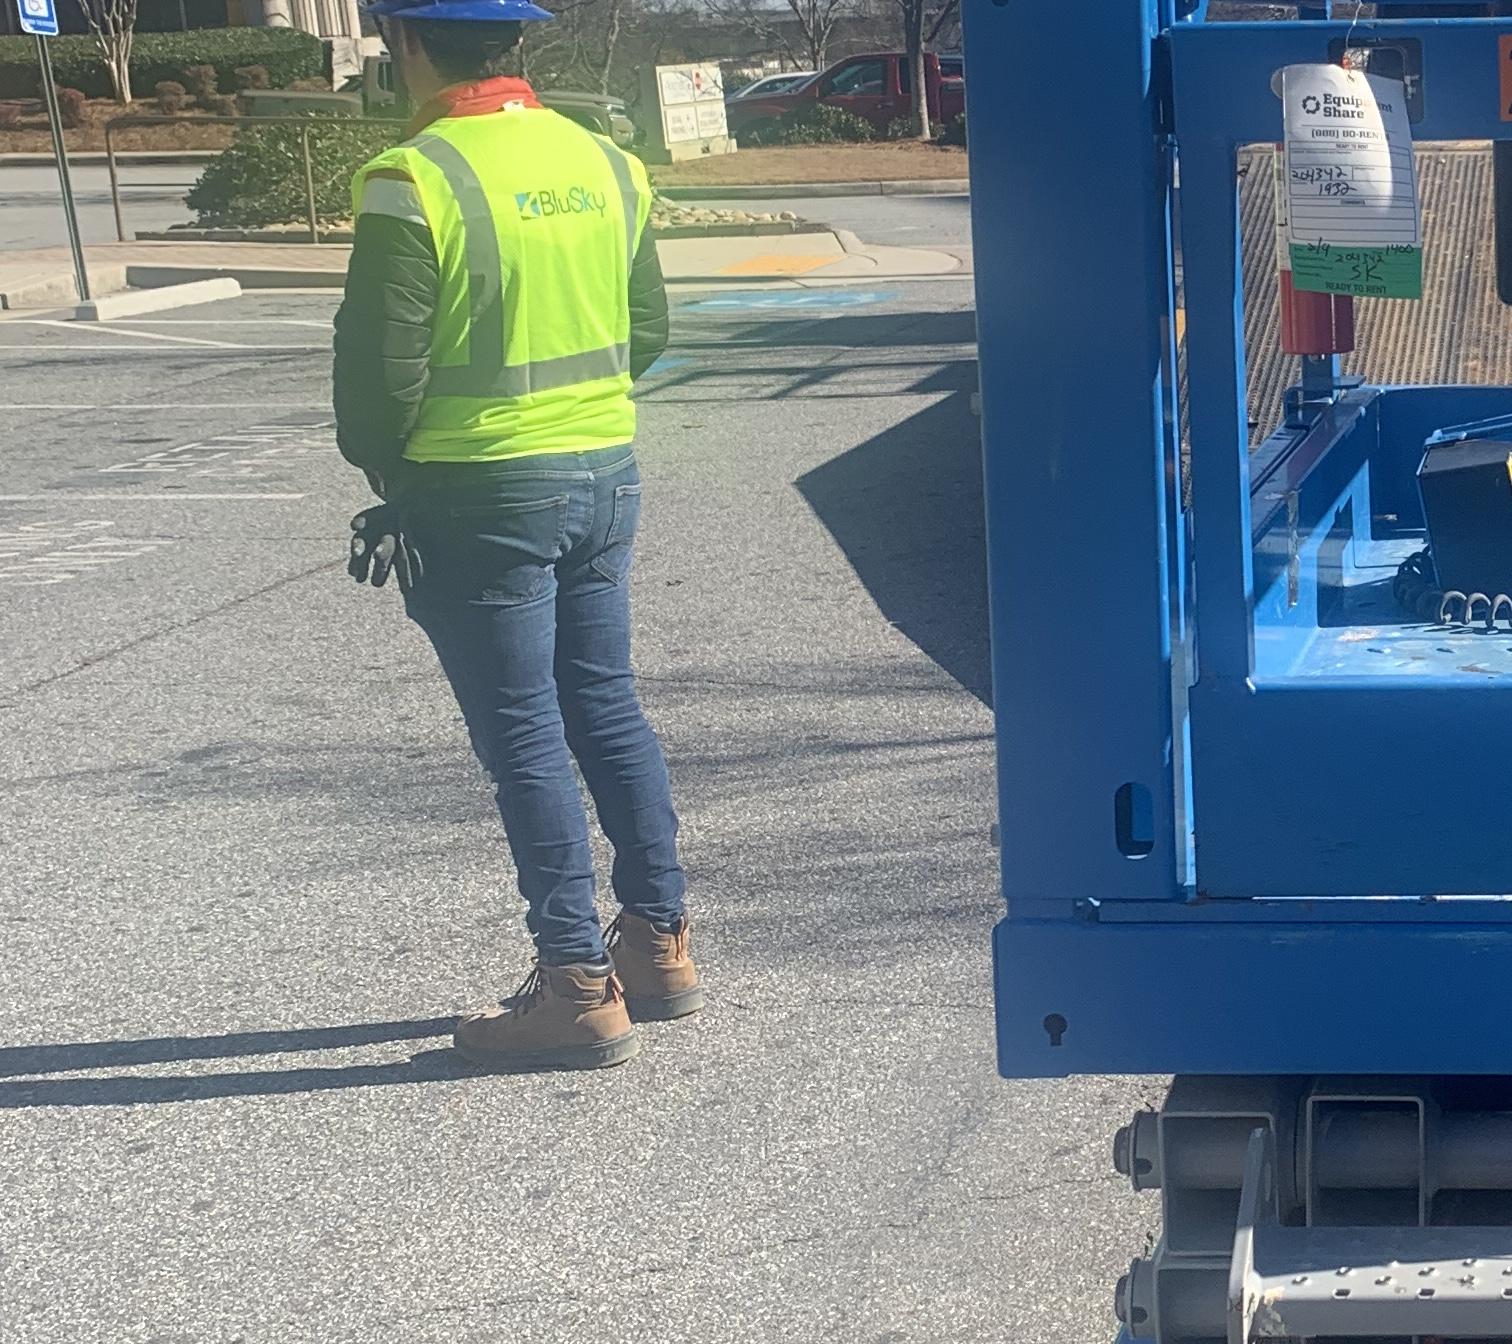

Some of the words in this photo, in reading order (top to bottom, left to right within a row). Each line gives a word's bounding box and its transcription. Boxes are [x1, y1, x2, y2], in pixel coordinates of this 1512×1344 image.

[1323, 93, 1393, 113] Equipnt
[1323, 106, 1365, 119] Share
[1292, 166, 1347, 184] 204342
[1319, 182, 1358, 196] 1932
[538, 186, 606, 218] BluSky
[1325, 281, 1352, 293] READY
[1366, 285, 1386, 294] RENT
